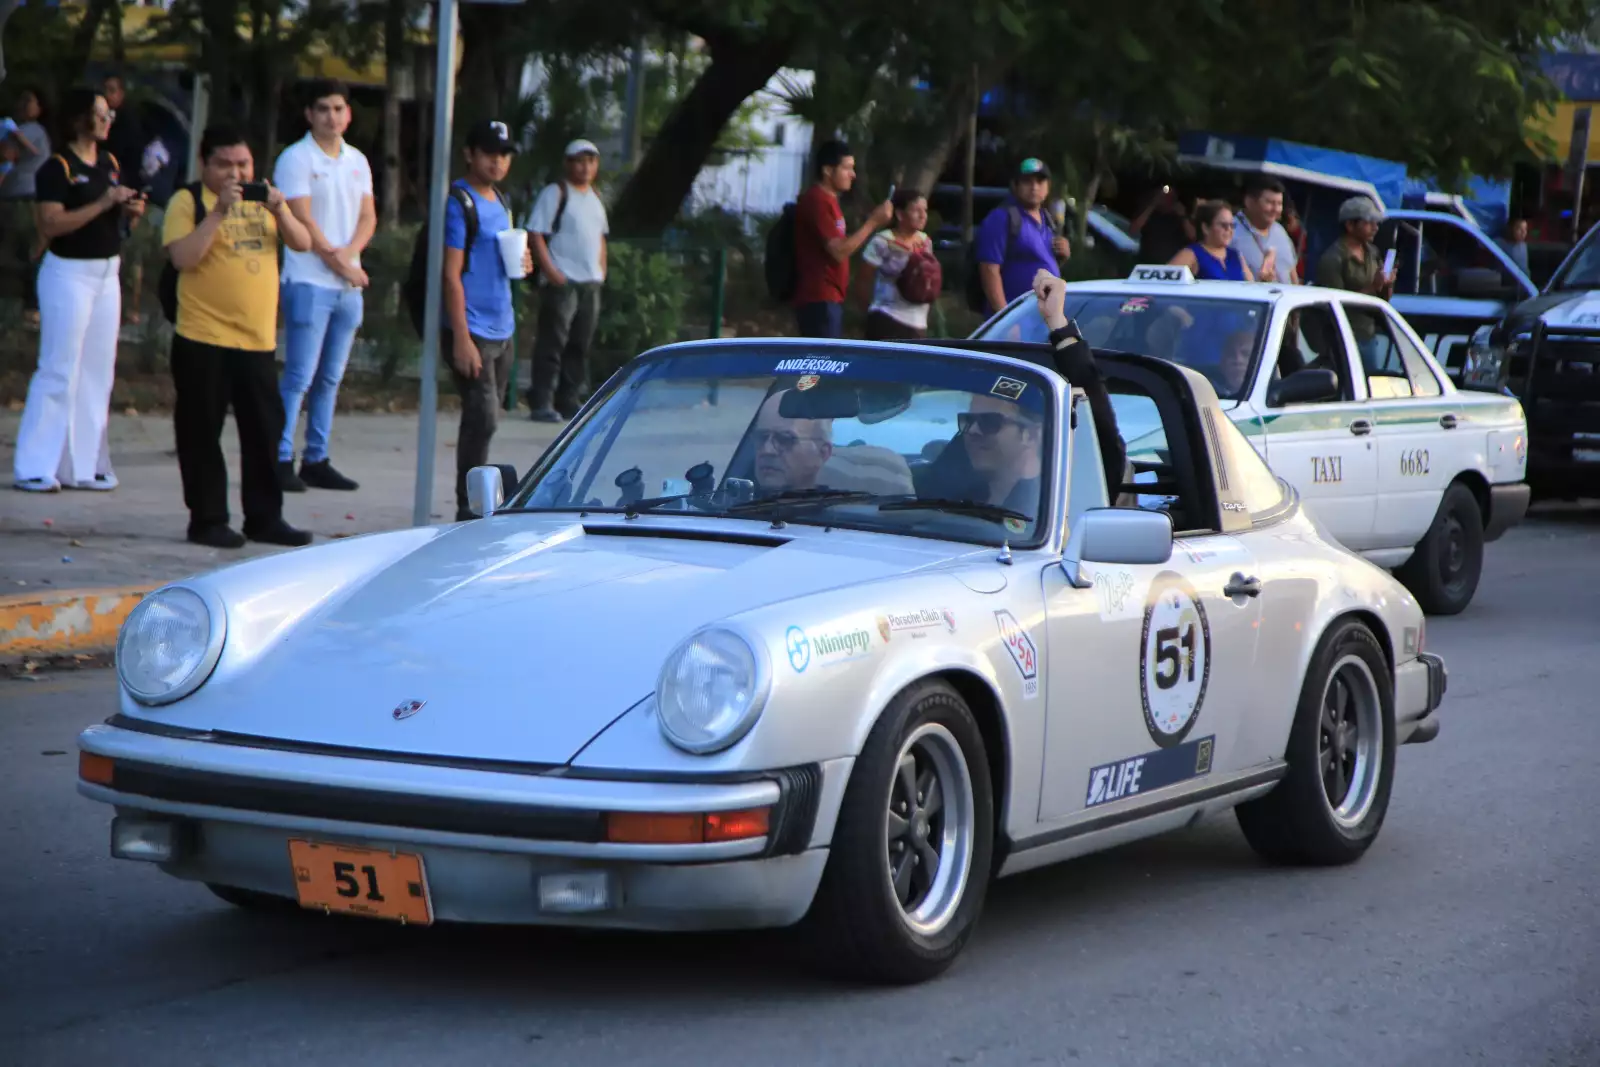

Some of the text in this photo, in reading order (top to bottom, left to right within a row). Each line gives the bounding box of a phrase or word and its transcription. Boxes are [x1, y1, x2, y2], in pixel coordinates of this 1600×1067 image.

[1136, 269, 1183, 280] TAXI
[774, 359, 849, 373] ANDERSON'S
[1311, 456, 1342, 483] TAXI
[1400, 448, 1430, 476] 6682
[888, 608, 941, 627] Porsche Club
[813, 628, 870, 656] Minigrip
[1155, 623, 1195, 690] 51
[333, 861, 386, 903] 51
